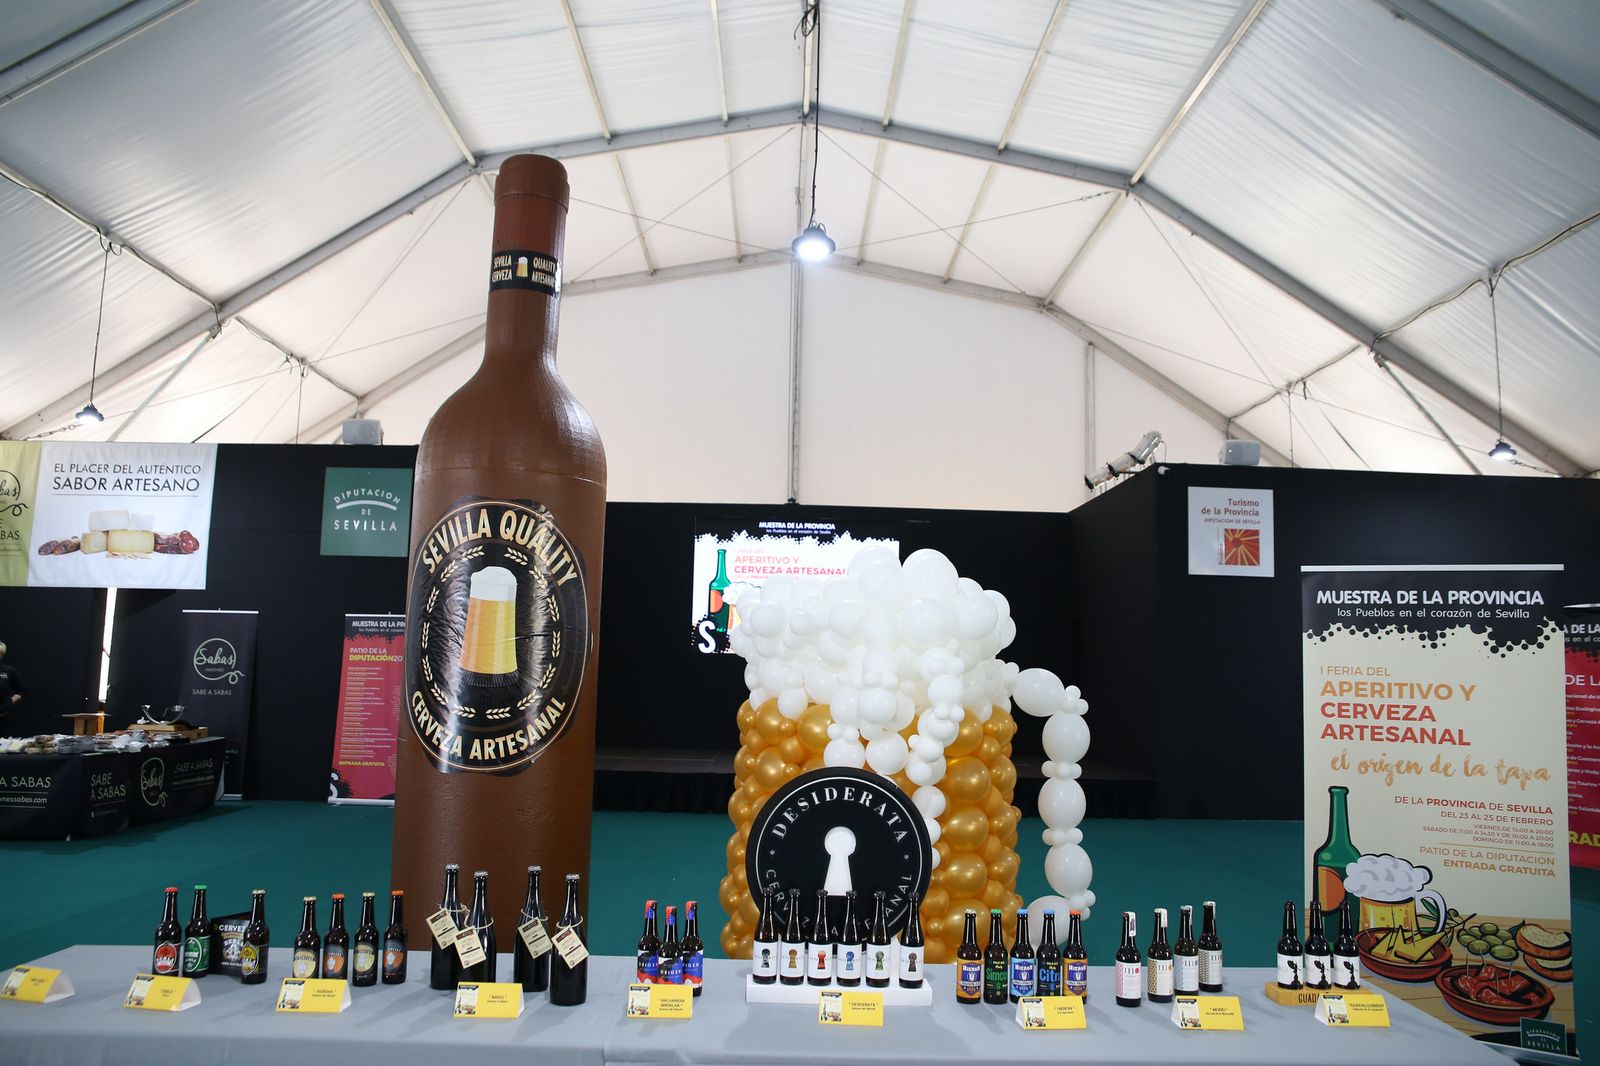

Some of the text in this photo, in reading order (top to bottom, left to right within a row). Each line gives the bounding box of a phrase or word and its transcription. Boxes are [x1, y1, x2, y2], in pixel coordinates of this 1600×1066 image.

[493, 254, 556, 274] SEVILLA QUALITY
[54, 462, 201, 475] EL PLACER DEL AUTÉNTICO
[52, 476, 200, 493] SABOR ARTESANO
[1228, 498, 1260, 507] Turismo
[361, 508, 371, 516] DE
[1201, 506, 1260, 517] de la Provincia
[333, 519, 397, 531] SEVILLA
[759, 521, 786, 529] MUESTRA
[796, 522, 803, 530] LA
[735, 555, 800, 565] APERITIVO Y
[734, 565, 783, 575] CERVEZA
[1316, 589, 1545, 606] MUESTRA DE LA PROVINCIA
[1337, 607, 1530, 619] los Pueblos en el corazón de Sevilla
[352, 620, 379, 628] MUESTRA
[1570, 624, 1586, 634] DE
[195, 648, 235, 667] Sabas
[1326, 666, 1363, 676] FERIA
[1366, 667, 1391, 677] DEL
[1320, 680, 1477, 702] APERITIVO Y
[1320, 701, 1437, 723] CERVEZA
[1320, 723, 1472, 747] ARTESANAL
[1330, 748, 1552, 791] el origen de la tapa
[11, 776, 52, 788] SABAS
[90, 772, 113, 787] SABE
[90, 784, 126, 801] A SABAS
[1394, 796, 1553, 815] DE LA PROVINCIA DE SEVILLA
[771, 786, 909, 844] DESIDERATA
[1440, 811, 1553, 826] DEL 23 AL 25 DE FEBRERO
[1422, 825, 1448, 833] SÁBADO
[1473, 824, 1501, 832] VIERNES
[1535, 828, 1554, 836] 20:00
[1472, 836, 1504, 845] DOMINGO
[1419, 846, 1450, 857] PATIO
[1452, 848, 1467, 858] DE
[1470, 850, 1485, 860] LA
[1443, 859, 1557, 878] ENTRADA GRATUITA
[1039, 968, 1061, 982] Citr
